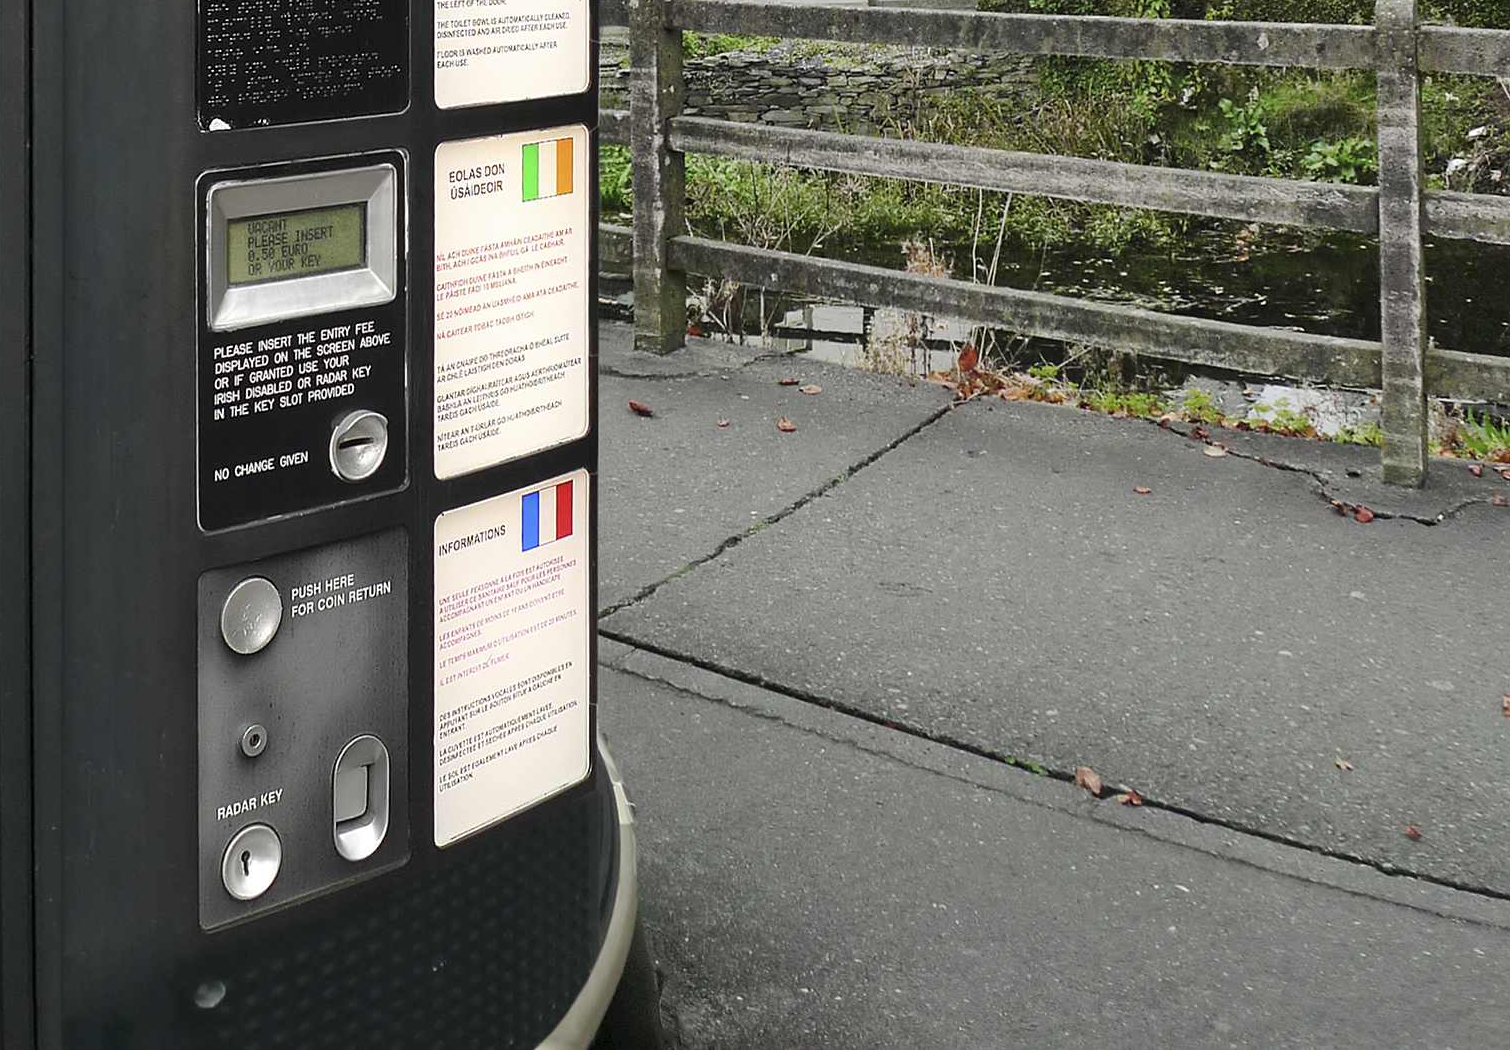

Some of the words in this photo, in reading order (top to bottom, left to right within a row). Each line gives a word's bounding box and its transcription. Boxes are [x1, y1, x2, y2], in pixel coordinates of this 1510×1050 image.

[449, 167, 482, 183] EOLAS
[485, 163, 505, 176] DON
[451, 180, 503, 200] ÚSÁIDEOIR
[248, 219, 287, 235] VACANT
[248, 232, 288, 249] PLEASE
[296, 226, 333, 242] INSERT
[248, 263, 262, 275] OR
[269, 259, 295, 272] YOUR
[302, 254, 321, 267] KEY
[282, 243, 308, 258] EURO
[214, 342, 253, 359] PLEASE
[258, 335, 292, 352] INSERT
[297, 331, 316, 345] THE
[321, 325, 351, 341] ENTRY
[355, 321, 375, 335] FEE
[215, 354, 268, 375] DISPLAYED
[274, 350, 288, 364] ON
[294, 346, 312, 361] THE
[316, 339, 355, 357] SCREEN
[360, 333, 391, 349] ABOVE
[214, 376, 229, 390] OR
[234, 373, 244, 386] IF
[249, 365, 293, 383] GRANTED
[299, 360, 318, 375] USE
[324, 355, 350, 370] YOUR
[214, 389, 240, 405] IRISH
[246, 380, 292, 399] DISABLED
[297, 376, 311, 390] OR
[316, 370, 347, 386] RADAR
[353, 365, 371, 380] KEY
[214, 408, 224, 420] IN
[230, 403, 249, 418] THE
[254, 398, 275, 413] KEY
[280, 393, 303, 408] SLOT
[308, 383, 355, 403] PROVIDED
[214, 468, 229, 481] NO
[234, 458, 275, 477] CHANGE
[280, 451, 308, 467] GIVEN
[439, 524, 506, 557] INFORMATIONS
[292, 582, 321, 600] PUSH
[325, 573, 354, 592] HERE
[292, 602, 314, 618] FOR
[317, 593, 345, 611] COIN
[349, 581, 391, 603] RETURN
[217, 797, 256, 820] RADAR
[261, 788, 282, 806] KEY
